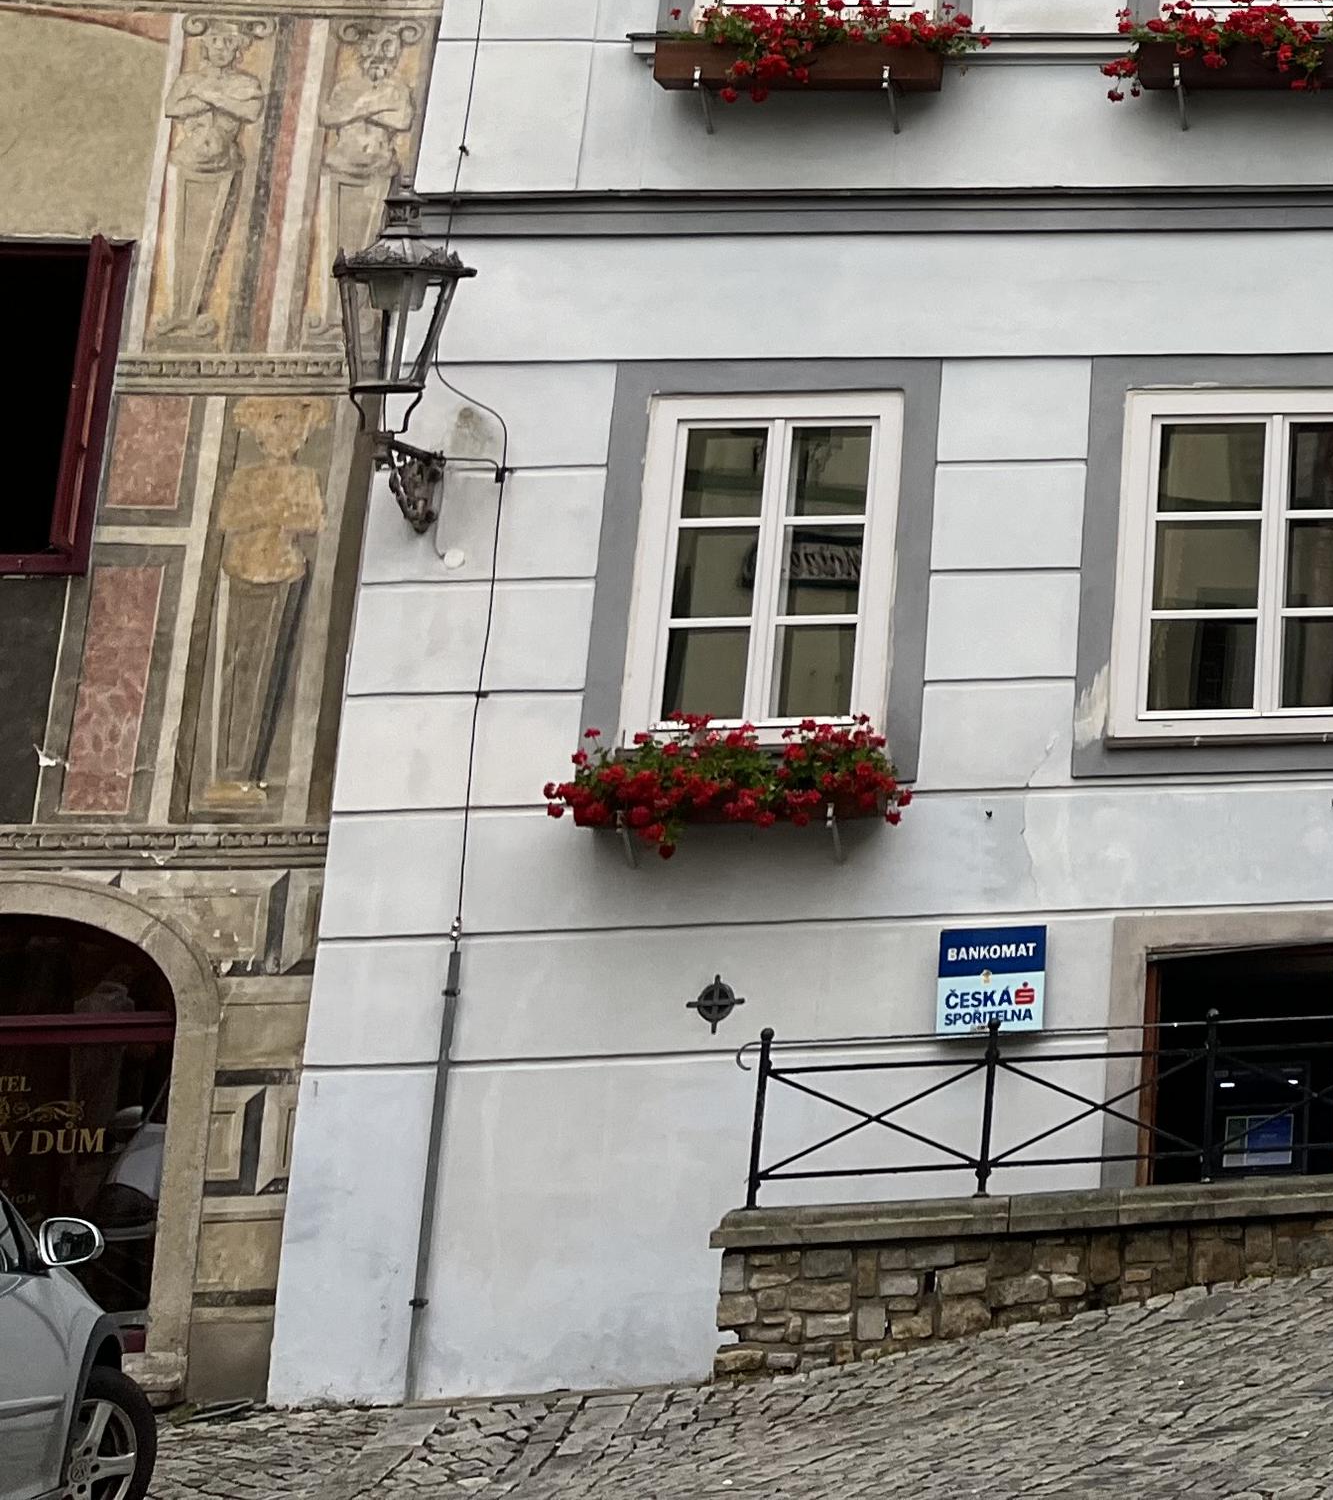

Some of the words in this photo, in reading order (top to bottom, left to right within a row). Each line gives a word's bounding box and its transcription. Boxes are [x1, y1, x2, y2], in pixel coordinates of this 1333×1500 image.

[947, 942, 1036, 961] BANKOMAT
[945, 986, 1013, 1010] ČESKÁ
[944, 1008, 1033, 1026] SPOŘITELNA
[29, 1121, 107, 1155] DŮM
